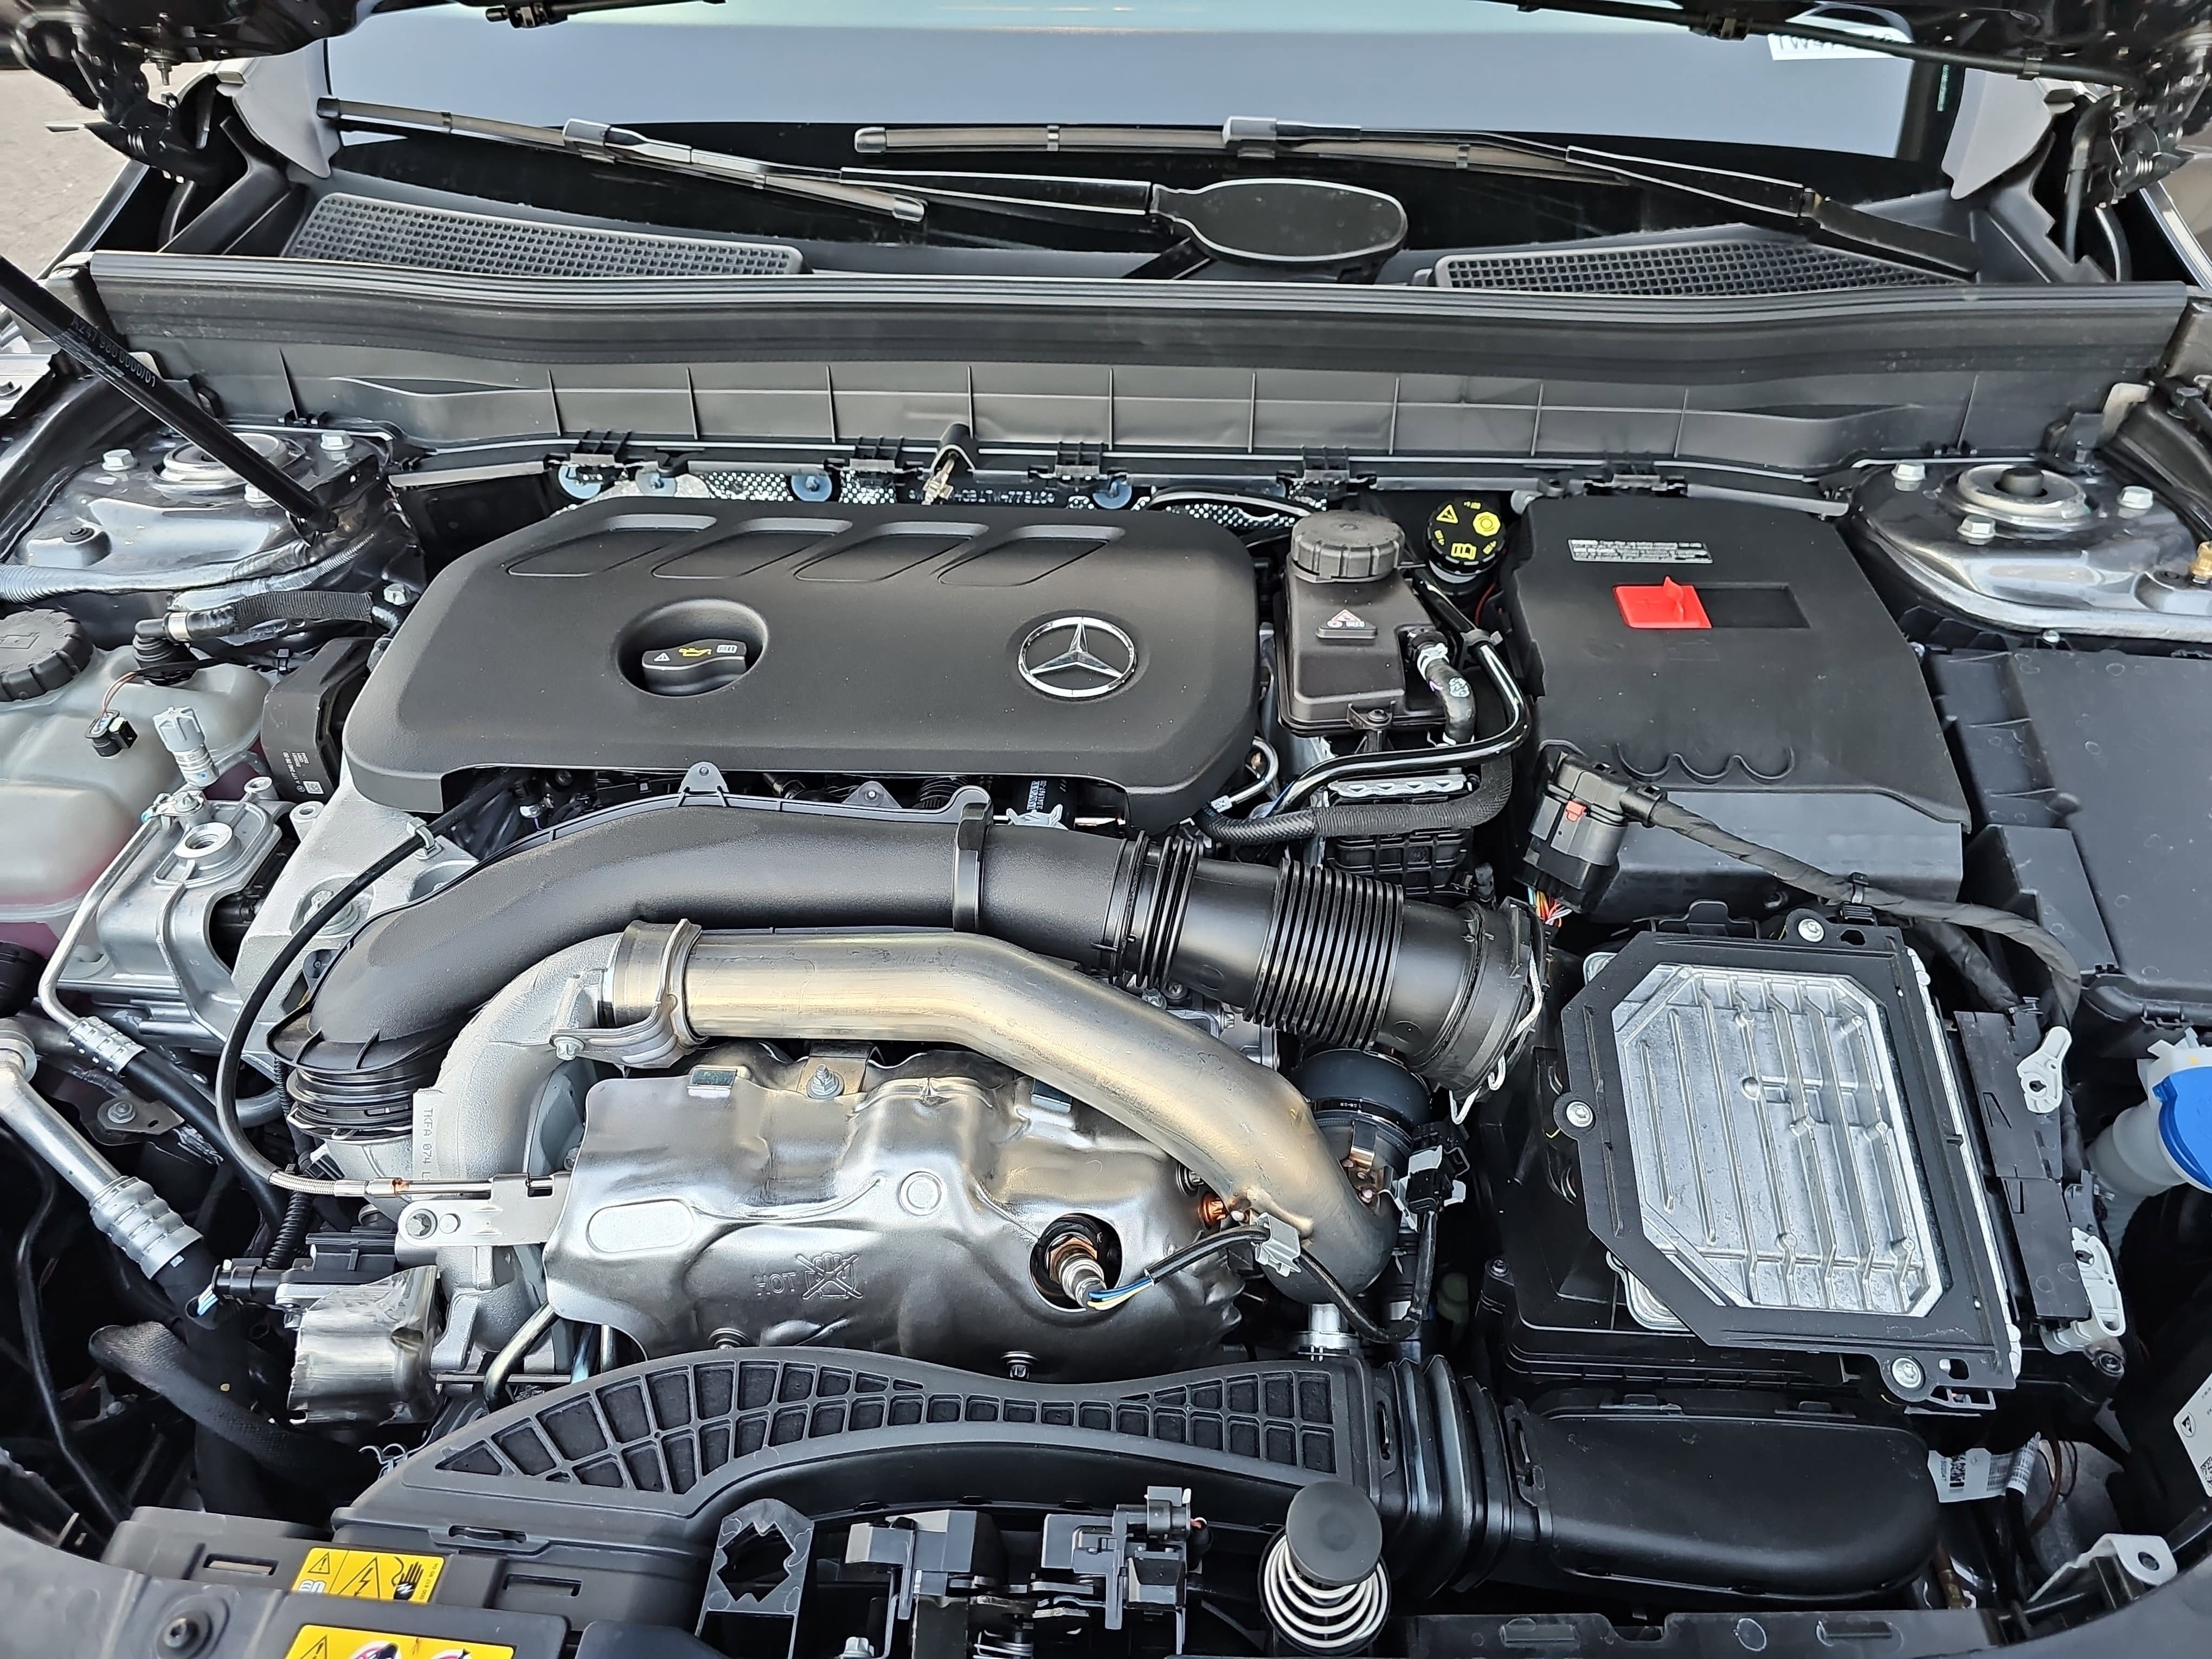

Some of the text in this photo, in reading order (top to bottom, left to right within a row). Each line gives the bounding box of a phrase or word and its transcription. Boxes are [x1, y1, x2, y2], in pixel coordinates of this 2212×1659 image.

[422, 1108, 433, 1181] TKFA 074 L
[753, 1272, 796, 1296] HOT
